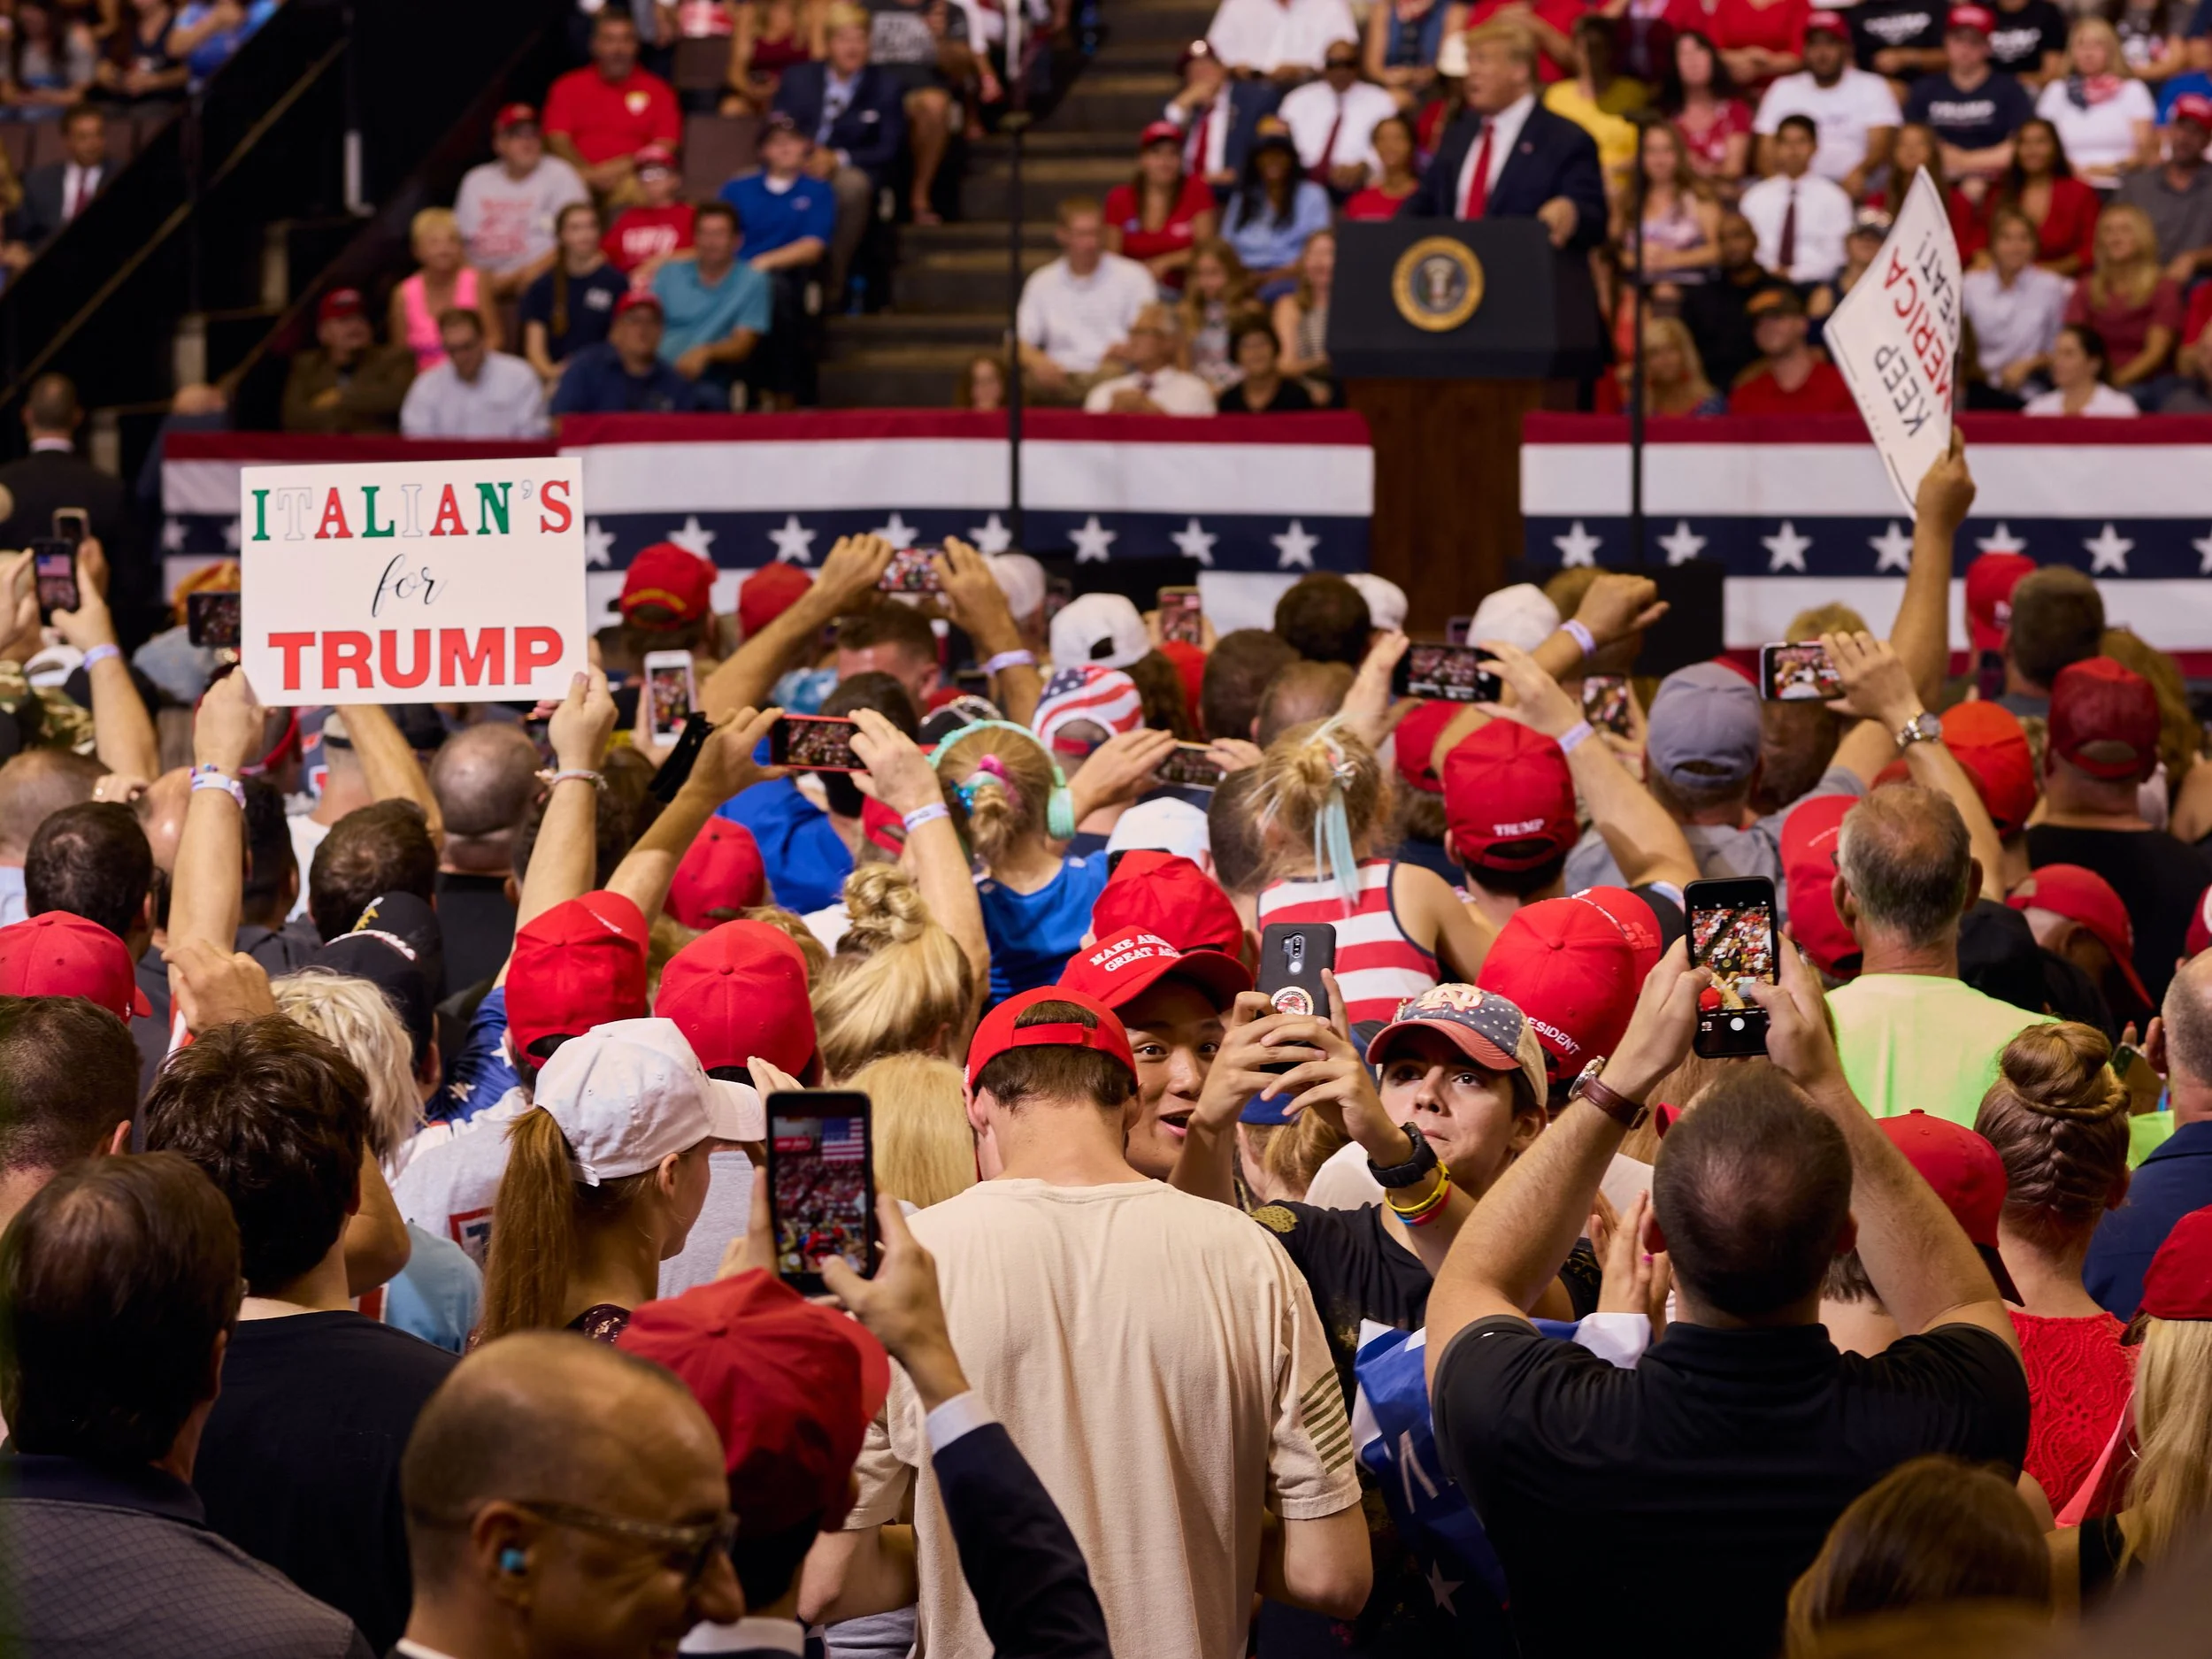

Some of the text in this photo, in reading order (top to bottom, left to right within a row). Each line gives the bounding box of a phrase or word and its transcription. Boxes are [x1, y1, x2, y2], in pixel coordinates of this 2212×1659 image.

[1874, 343, 1932, 438] KEEP
[251, 479, 573, 541] ITALIAN'S
[371, 552, 449, 618] for
[267, 625, 565, 691] TRUMP
[1493, 818, 1545, 837] TRUMP
[1089, 938, 1135, 966] MAKE
[1104, 946, 1155, 972] GREAT
[1526, 1016, 1582, 1056] ESIDENT
